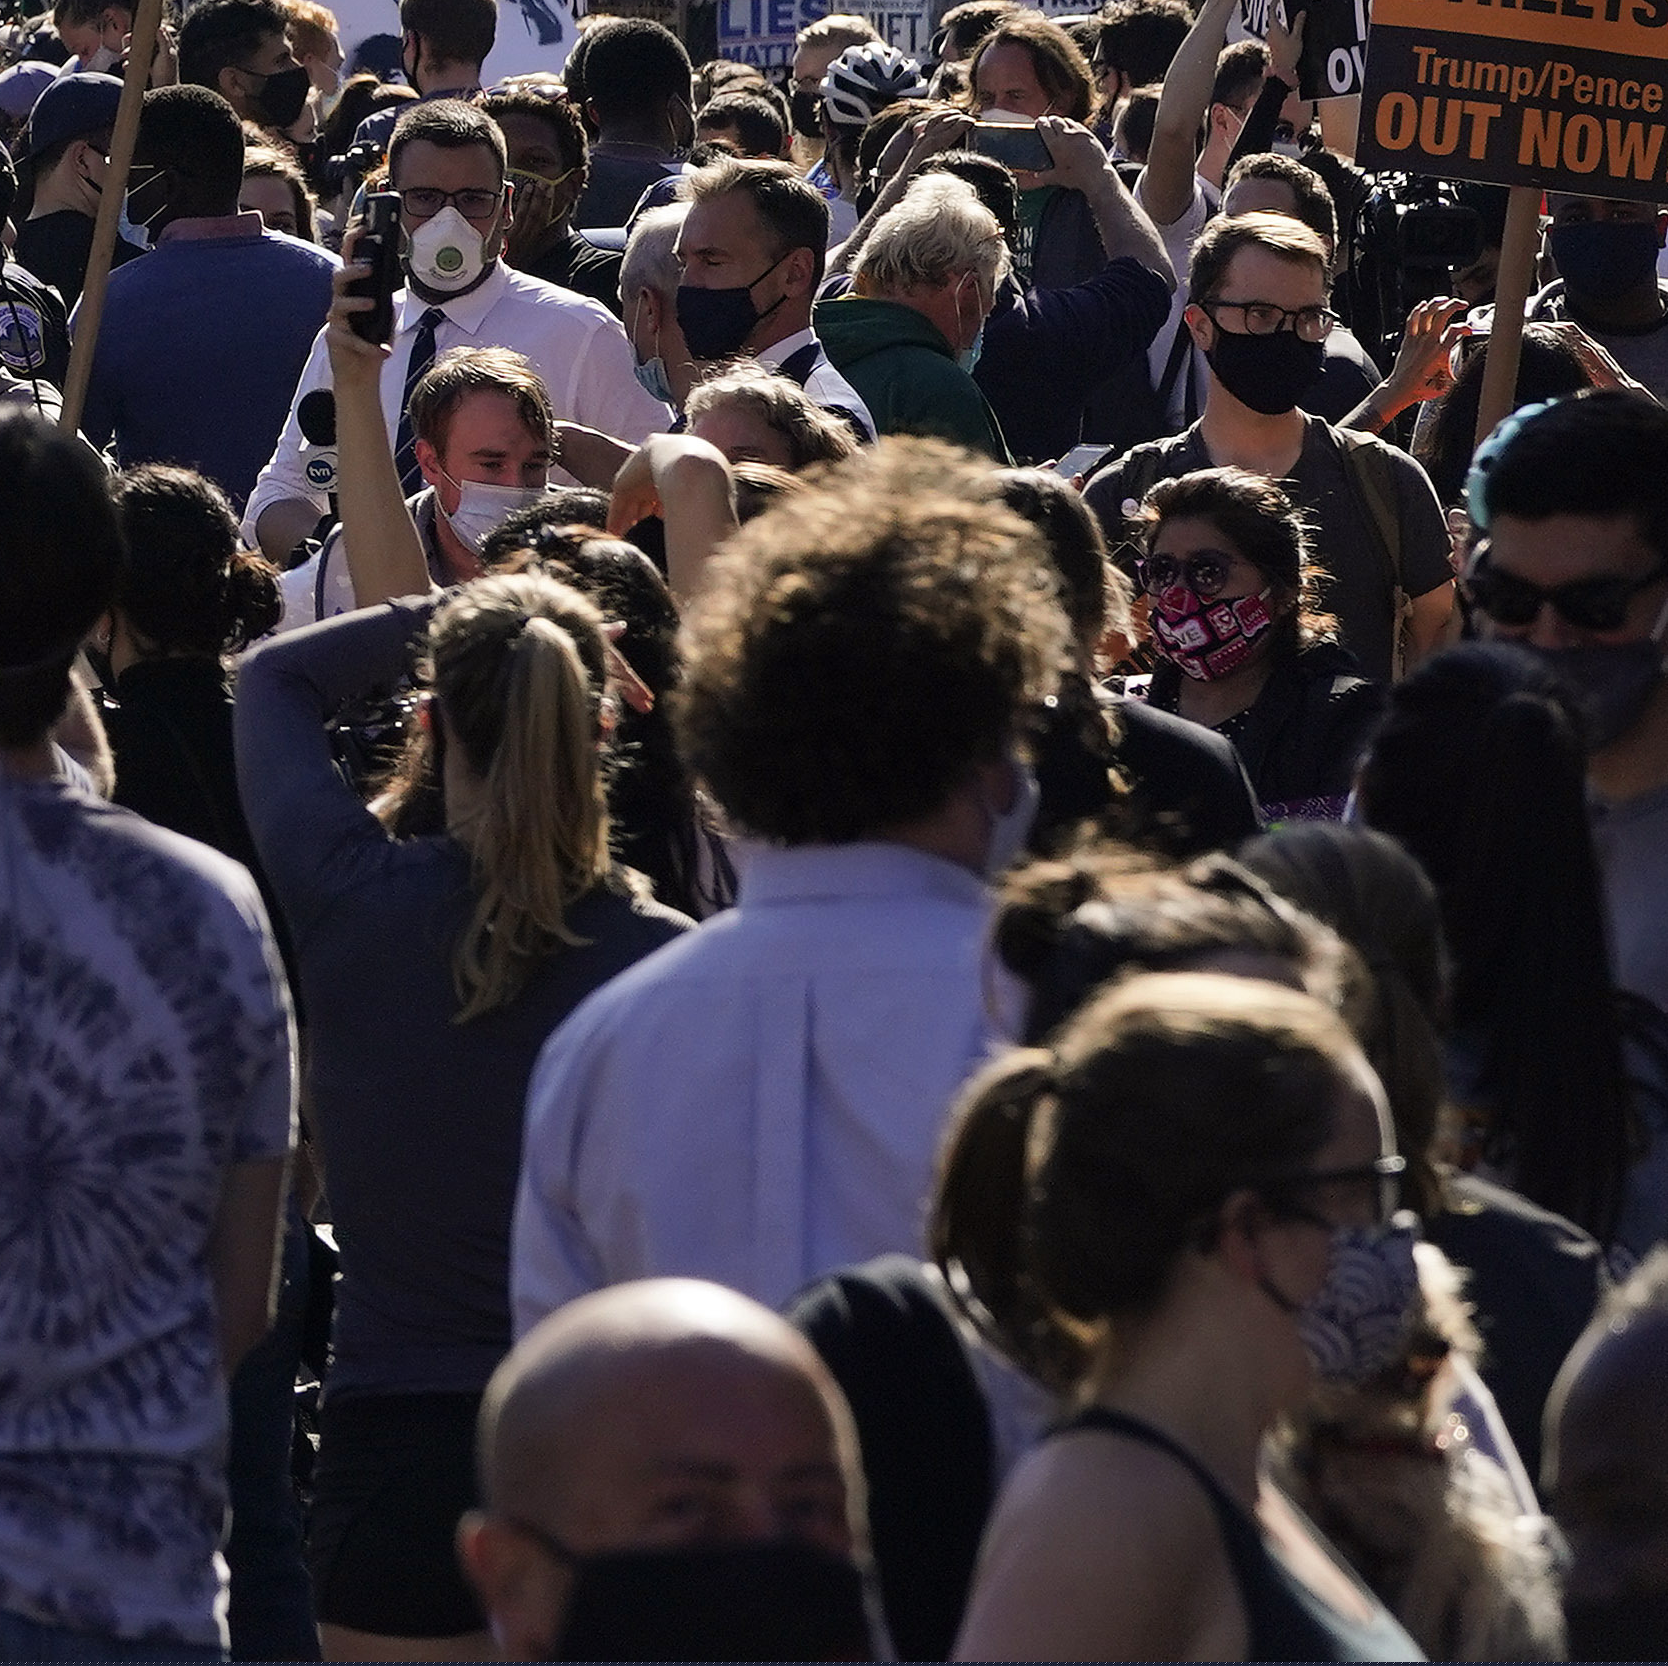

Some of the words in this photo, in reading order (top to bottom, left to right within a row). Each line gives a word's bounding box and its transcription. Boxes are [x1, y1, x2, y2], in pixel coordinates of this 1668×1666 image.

[720, 43, 792, 67] MATT
[1412, 45, 1664, 114] Trump/Pence
[1375, 91, 1503, 161] OUT
[308, 466, 331, 477] tvn
